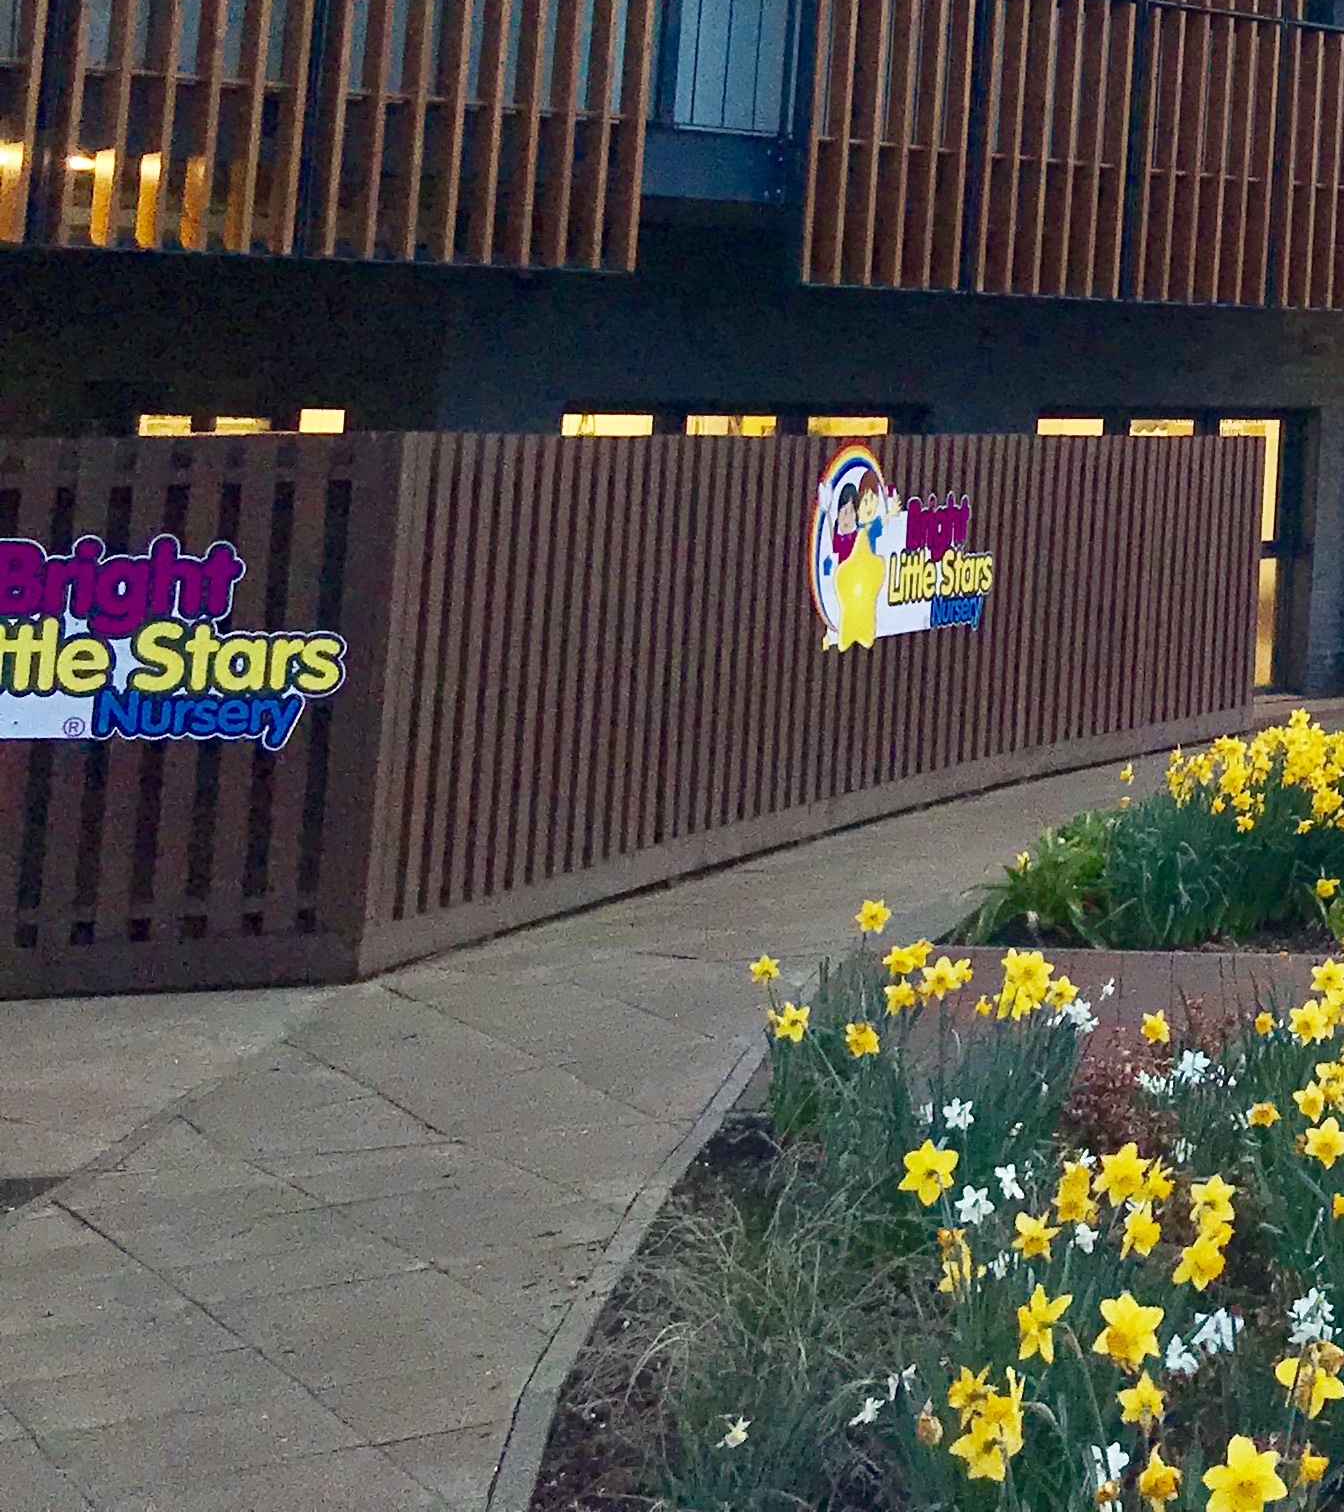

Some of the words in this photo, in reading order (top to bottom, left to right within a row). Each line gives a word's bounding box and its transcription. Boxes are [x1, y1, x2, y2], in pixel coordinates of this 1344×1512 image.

[906, 494, 970, 562] Bright
[0, 537, 243, 635] Bright
[888, 549, 937, 605] Little
[940, 548, 993, 596] Stars
[930, 595, 983, 628] Nursery
[131, 620, 343, 692] Stars
[96, 690, 302, 746] Nursery
